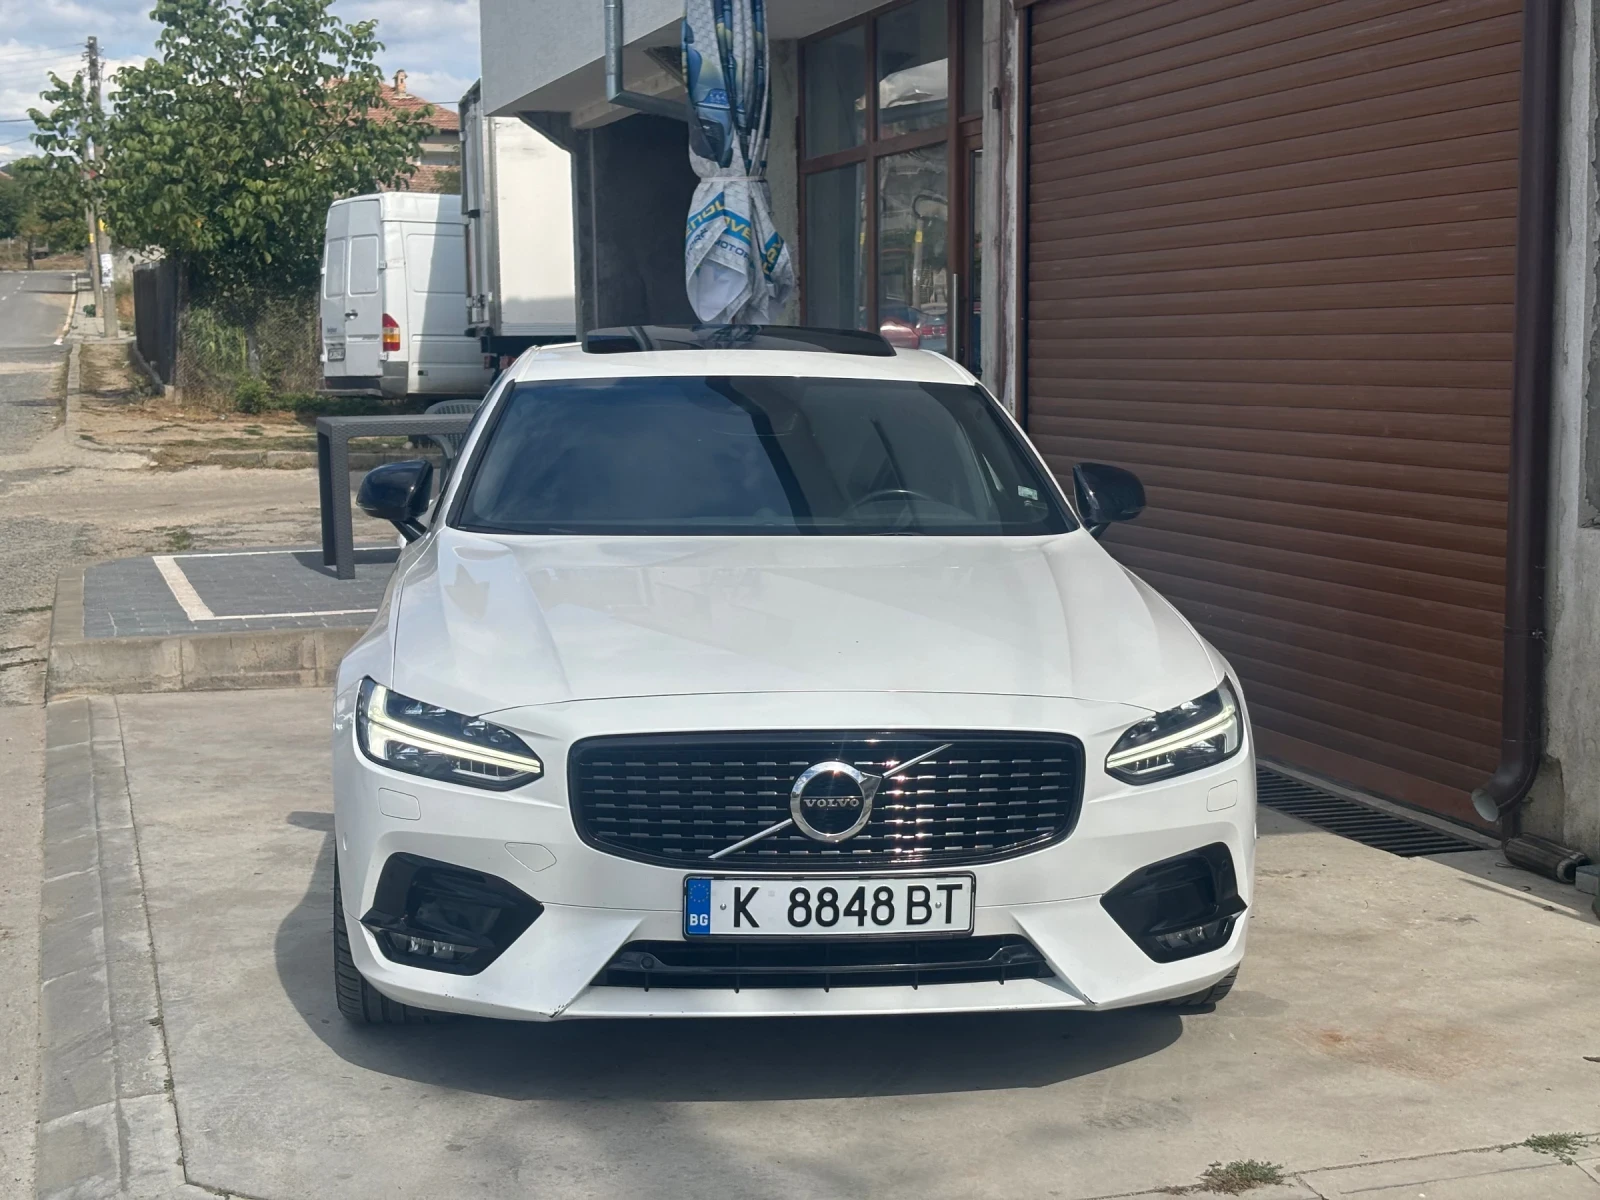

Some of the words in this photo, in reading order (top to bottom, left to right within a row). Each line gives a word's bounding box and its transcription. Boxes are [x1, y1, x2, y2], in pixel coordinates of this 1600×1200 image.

[803, 798, 860, 807] VOLVO
[733, 886, 760, 928] K
[787, 885, 895, 928] 8848
[906, 883, 963, 926] BT
[689, 913, 708, 927] BG
